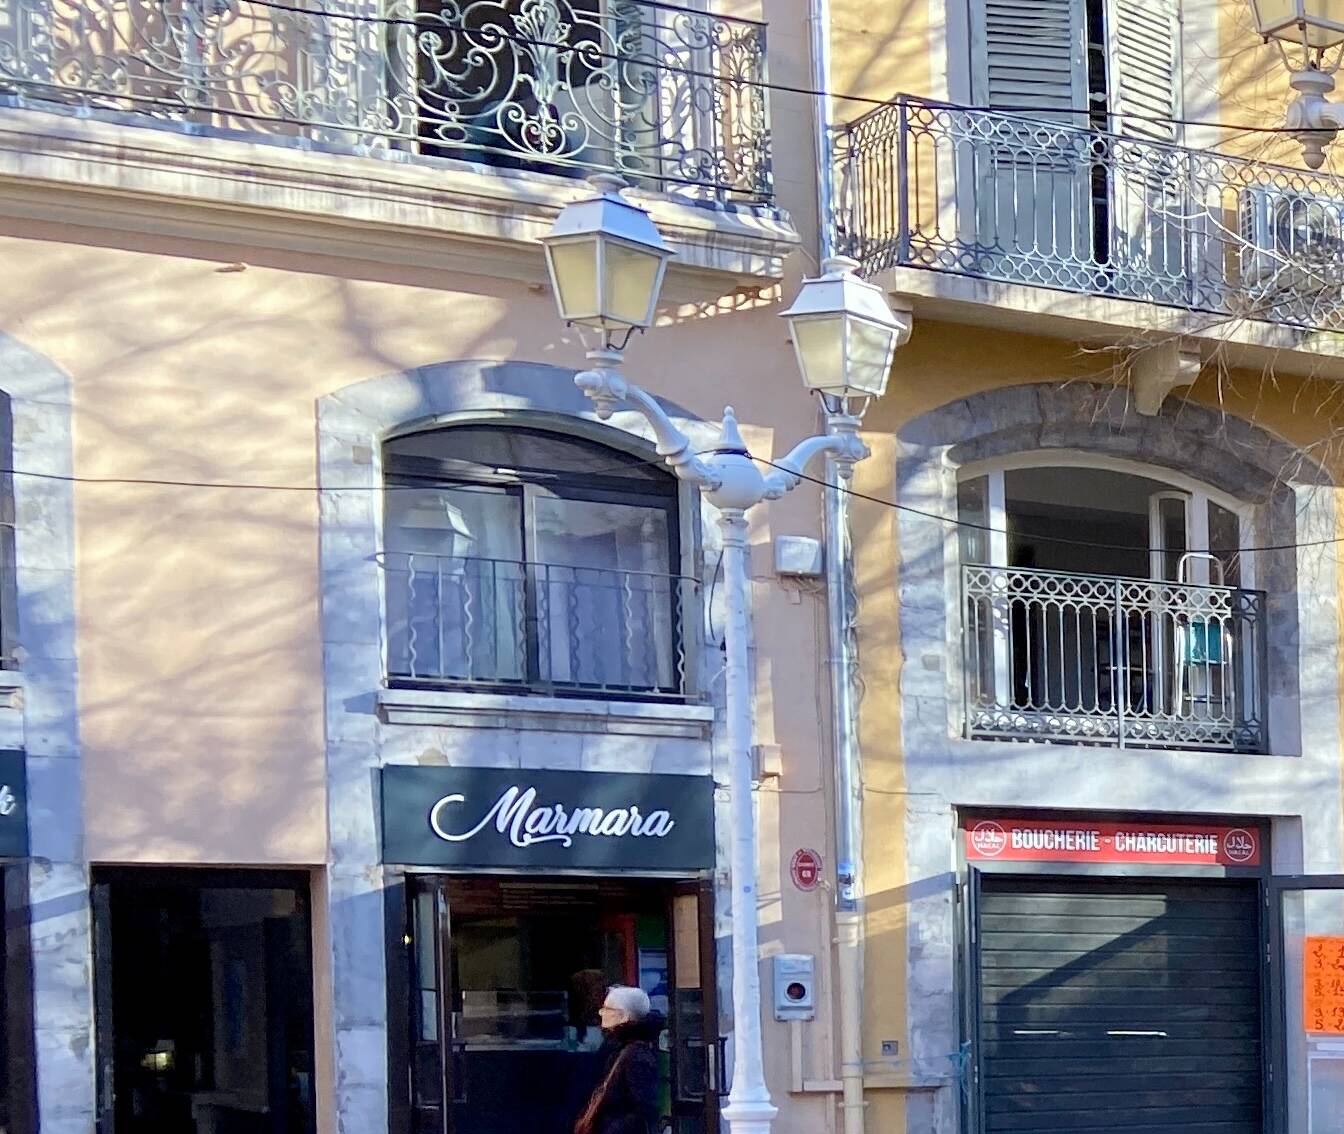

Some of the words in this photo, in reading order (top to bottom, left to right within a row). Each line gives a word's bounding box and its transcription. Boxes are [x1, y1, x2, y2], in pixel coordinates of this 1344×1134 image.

[431, 786, 674, 847] Marmara
[1012, 828, 1100, 851] BOUCHERIE
[1115, 831, 1217, 855] CHARCUTERIE
